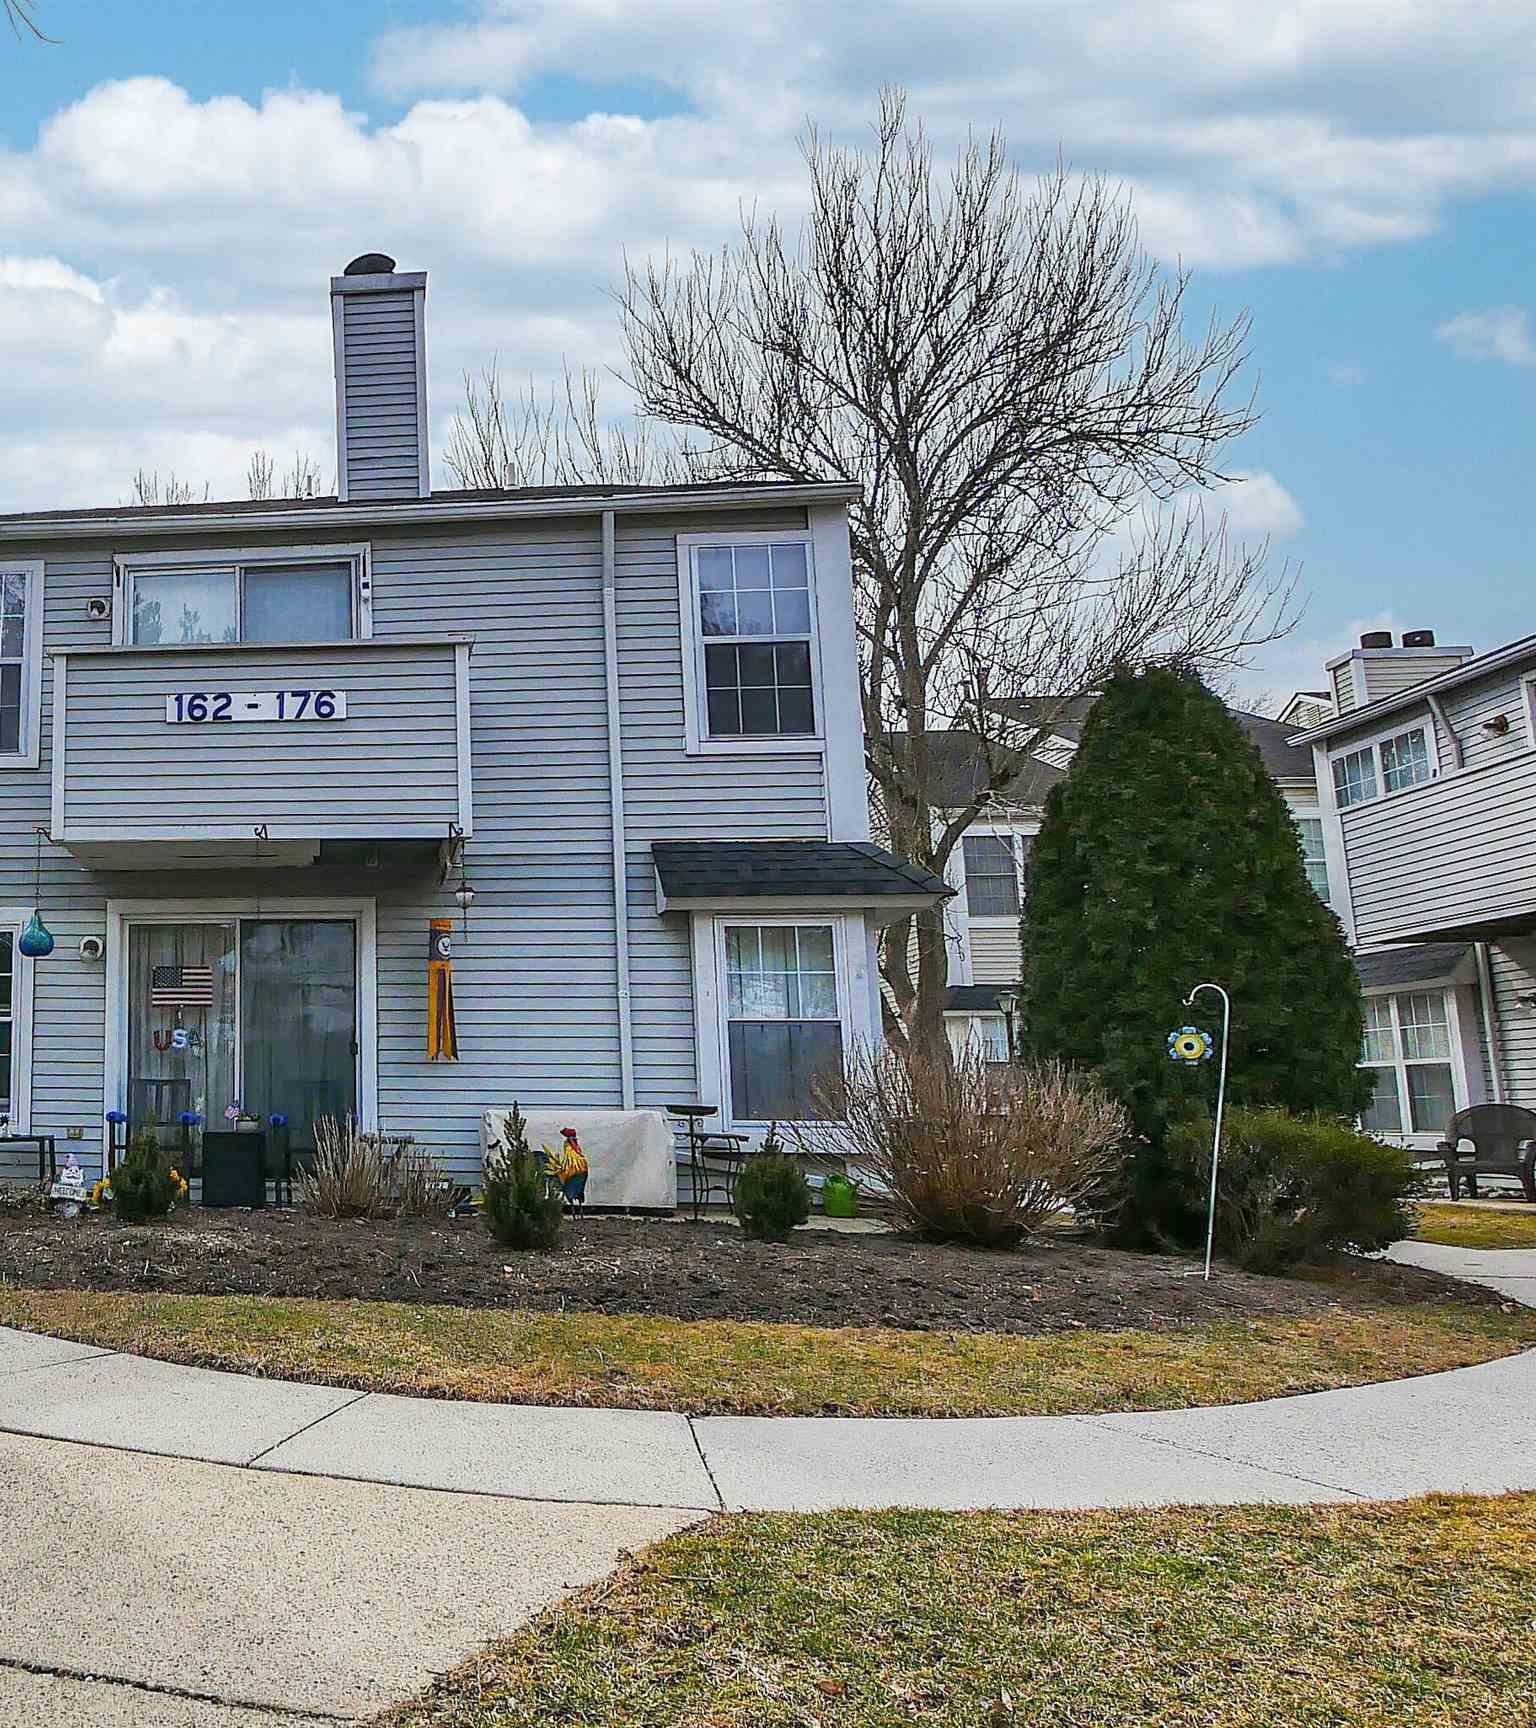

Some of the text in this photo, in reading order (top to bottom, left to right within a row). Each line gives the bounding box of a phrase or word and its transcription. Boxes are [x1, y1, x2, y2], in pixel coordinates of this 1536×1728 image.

[174, 692, 233, 722] 162
[276, 690, 336, 720] 176
[153, 1028, 203, 1052] USA
